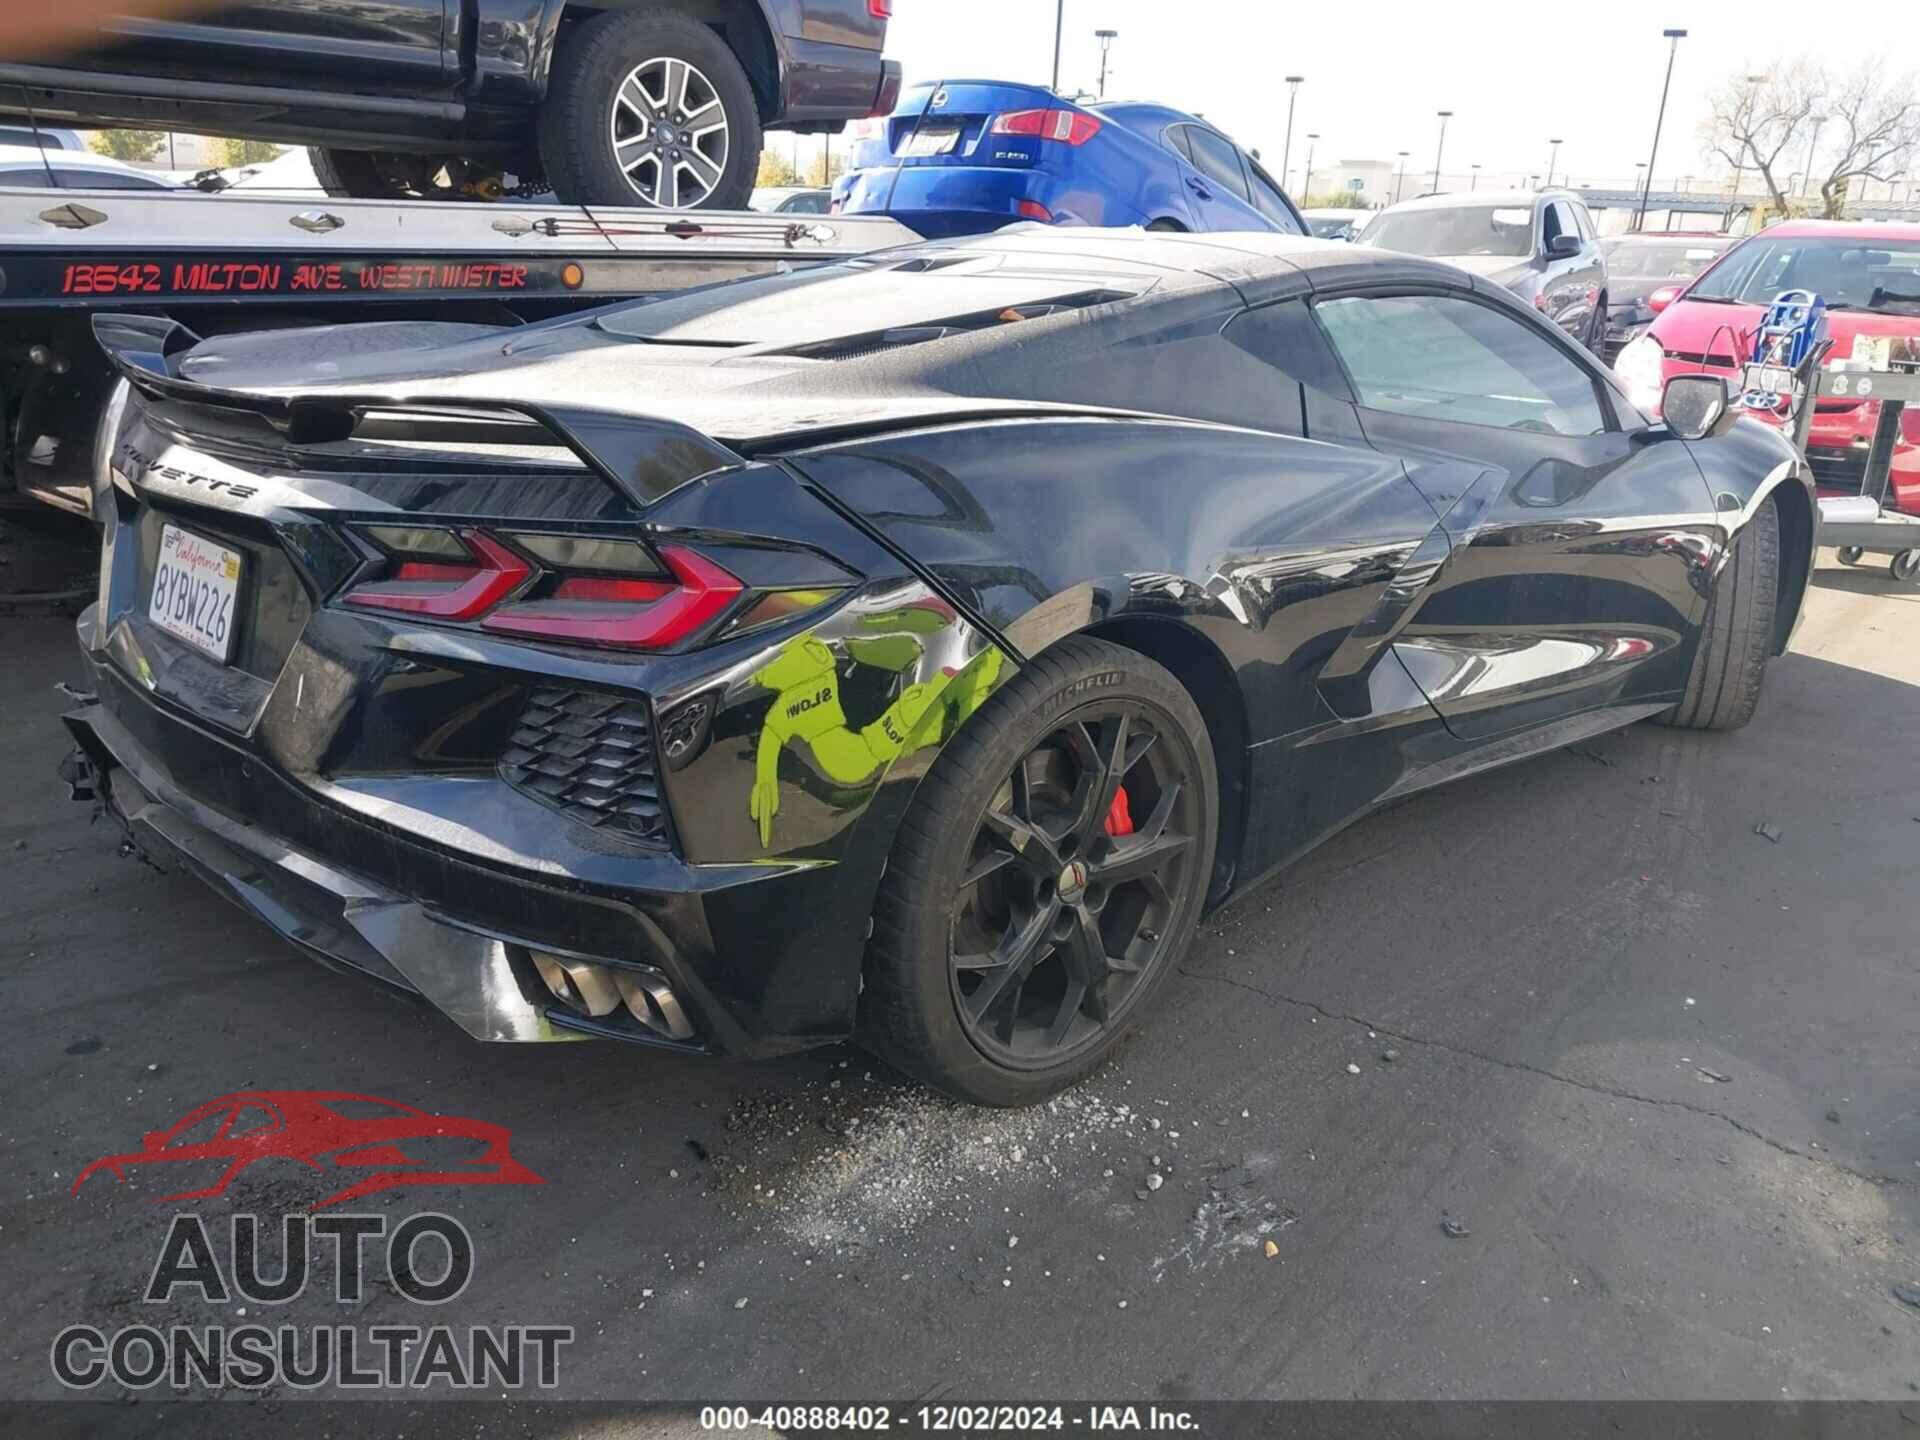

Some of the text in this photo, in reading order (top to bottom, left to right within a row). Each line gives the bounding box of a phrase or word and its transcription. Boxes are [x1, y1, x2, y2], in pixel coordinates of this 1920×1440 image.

[62, 263, 528, 293] 13642 MILTON AVE. WESTMINSTER
[154, 563, 231, 643] 8YBW226
[1042, 670, 1124, 716] MICHELIN
